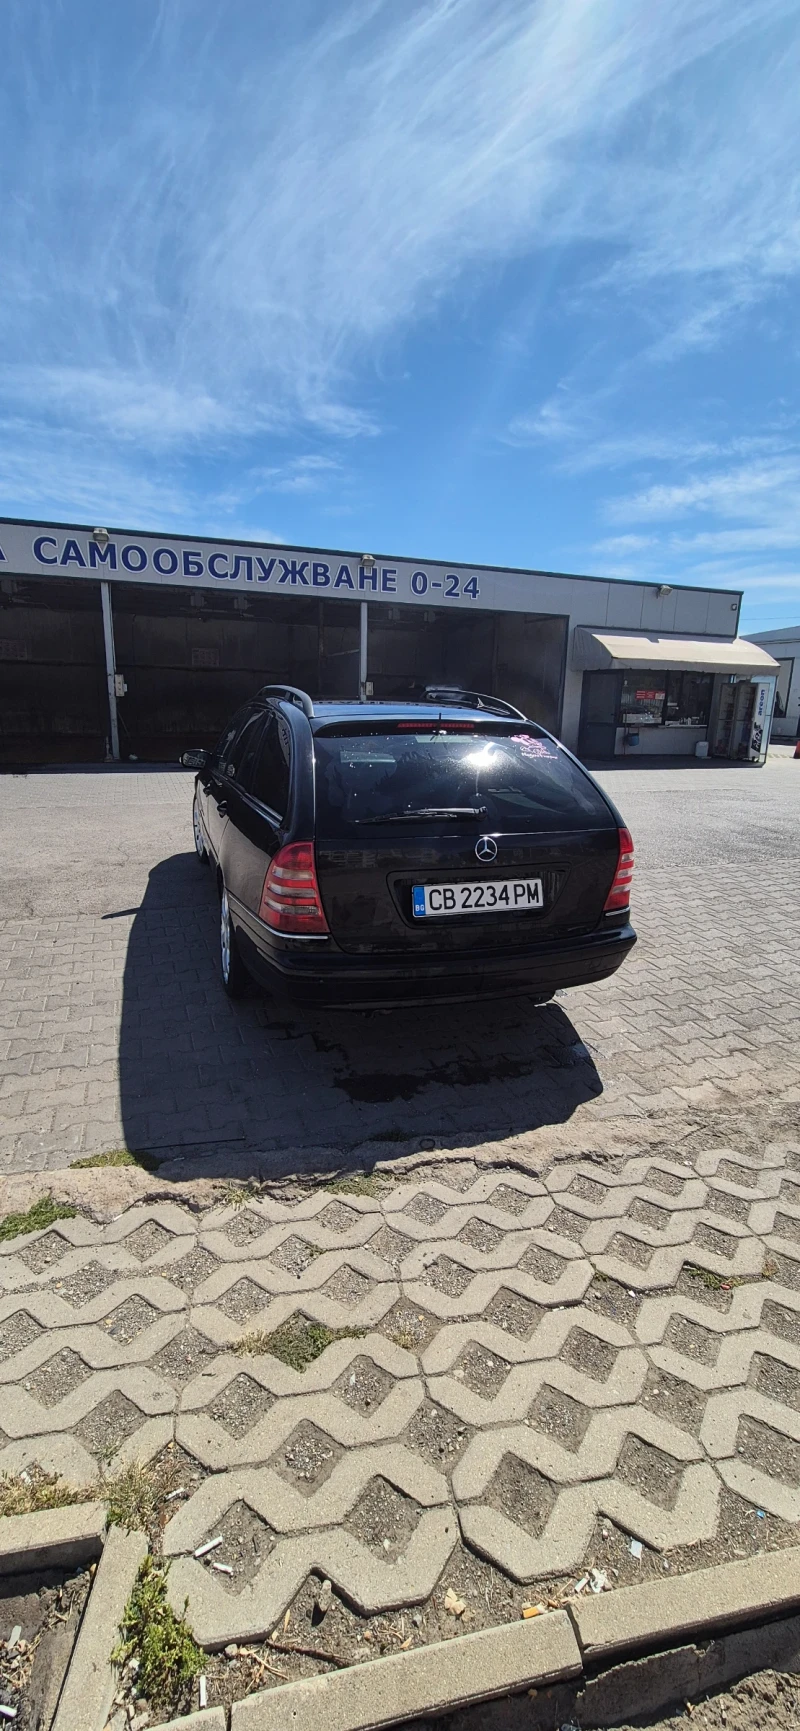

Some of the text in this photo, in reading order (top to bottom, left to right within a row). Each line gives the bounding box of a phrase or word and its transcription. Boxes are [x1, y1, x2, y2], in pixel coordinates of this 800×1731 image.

[33, 536, 480, 599] САМООБСЛУЖВАНЕ 0-24
[758, 689, 766, 716] areon
[415, 904, 425, 912] BG
[428, 882, 540, 911] CB 2234 PM
